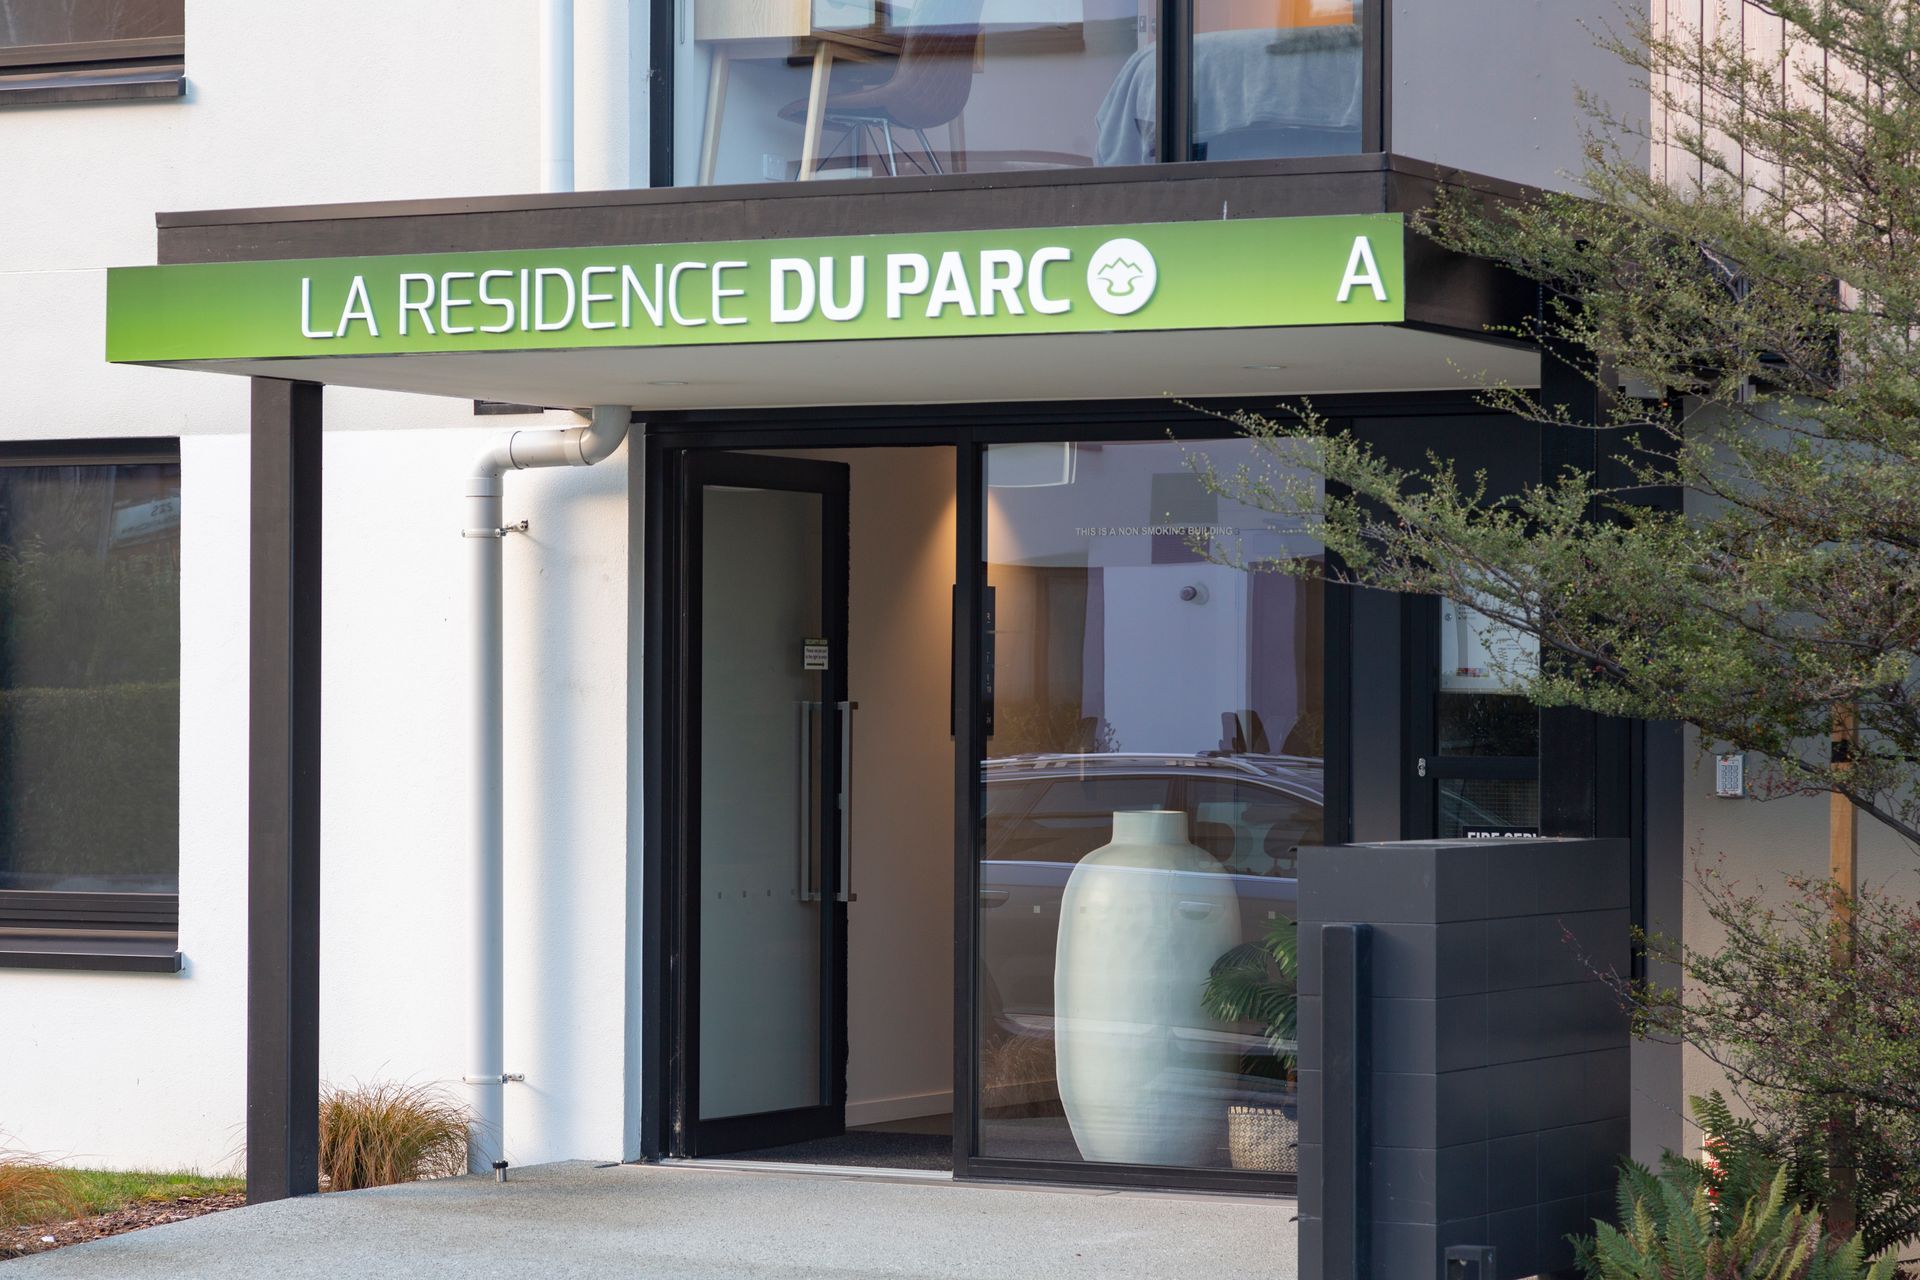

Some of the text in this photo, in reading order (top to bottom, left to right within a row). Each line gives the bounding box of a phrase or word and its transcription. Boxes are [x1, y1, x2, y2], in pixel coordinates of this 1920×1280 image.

[301, 247, 1071, 338] LA RESIDENCE DU PARC
[1336, 235, 1388, 302] A
[1075, 526, 1233, 536] THIS IS A NON SMOKING BUILDING
